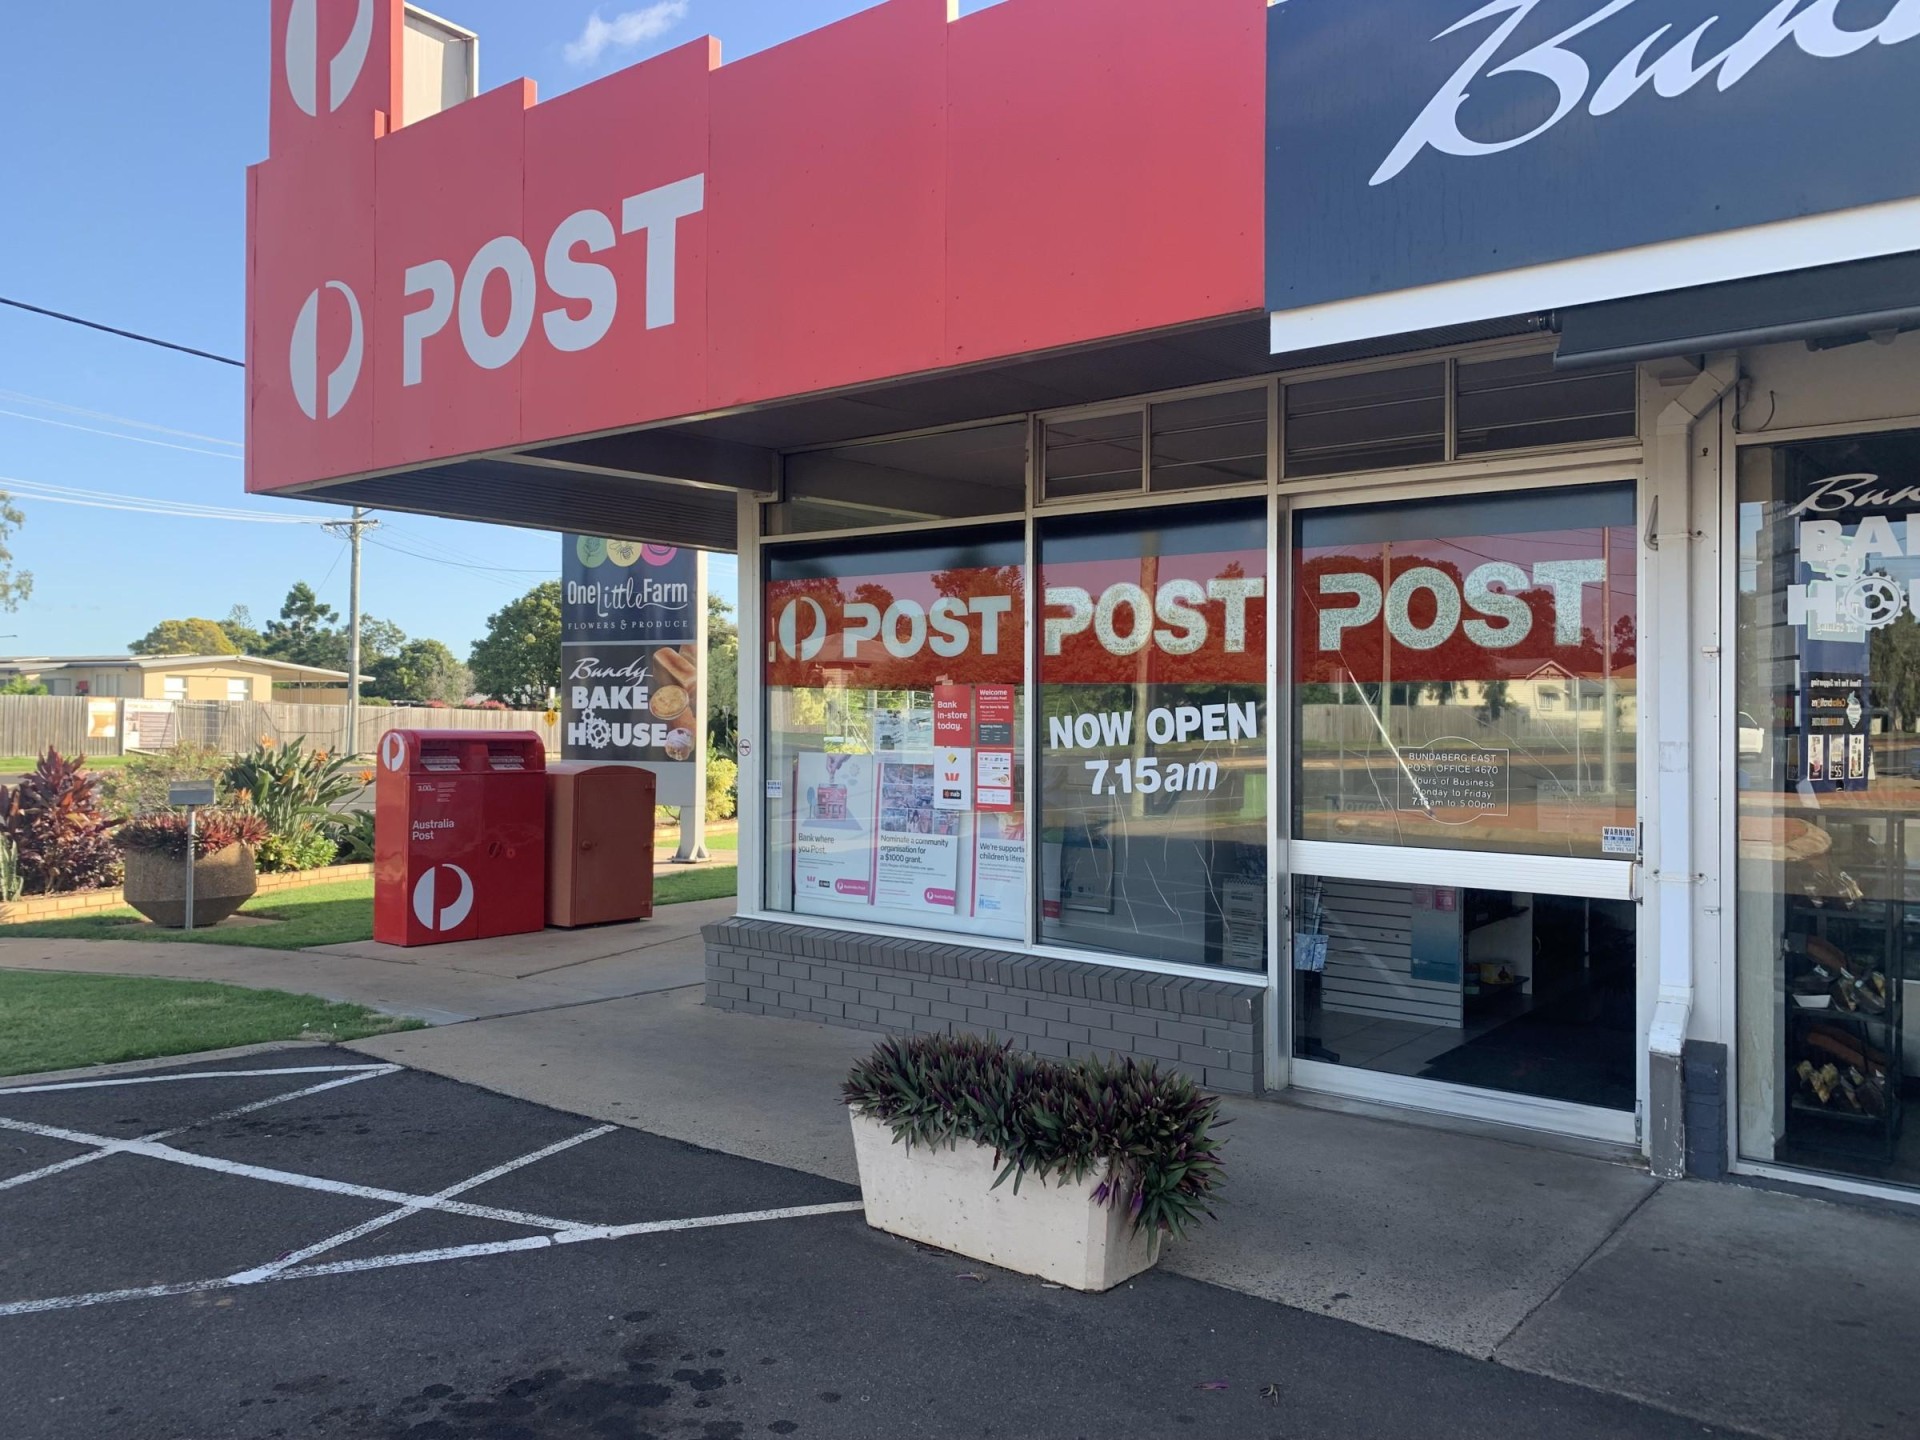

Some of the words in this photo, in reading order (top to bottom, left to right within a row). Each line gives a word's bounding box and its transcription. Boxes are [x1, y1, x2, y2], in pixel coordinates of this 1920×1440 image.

[403, 172, 705, 387] POST
[1800, 513, 1920, 563] BA
[567, 581, 596, 605] One
[596, 577, 643, 617] Little
[643, 578, 688, 603] Farm
[1319, 558, 1607, 651] POST
[1044, 577, 1265, 657] POST
[568, 622, 616, 630] FLOWERS
[620, 619, 627, 630] &
[631, 620, 689, 628] PRODUCE
[843, 595, 1011, 658] POST
[568, 655, 654, 688] Bundy
[572, 686, 649, 710] BAKE
[937, 701, 957, 709] Bank
[937, 722, 963, 731] today.
[1049, 711, 1133, 749] NOW
[1147, 701, 1258, 744] OPEN
[1408, 752, 1468, 762] BUNDABERG
[1471, 754, 1497, 763] EAST
[1408, 764, 1432, 772] POST
[1436, 764, 1471, 773] OFFICE
[1475, 765, 1499, 774] 4670
[1085, 757, 1218, 795] 7.15am
[1453, 778, 1495, 787] Business
[1412, 788, 1448, 797] Monday
[1452, 789, 1461, 797] to
[1464, 789, 1492, 799] Friday
[1447, 798, 1456, 806] to
[412, 819, 455, 830] Australia
[412, 830, 434, 840] Post
[1604, 827, 1635, 836] WARNING
[798, 833, 814, 842] Bank
[815, 834, 835, 843] where
[880, 834, 909, 844] Nominate
[915, 837, 949, 847] community
[810, 845, 827, 854] Post.
[880, 844, 917, 854] organisation
[917, 845, 926, 854] for
[980, 842, 997, 850] We're
[885, 853, 904, 862] $1000
[904, 856, 922, 864] grant.
[980, 852, 1009, 862] children's
